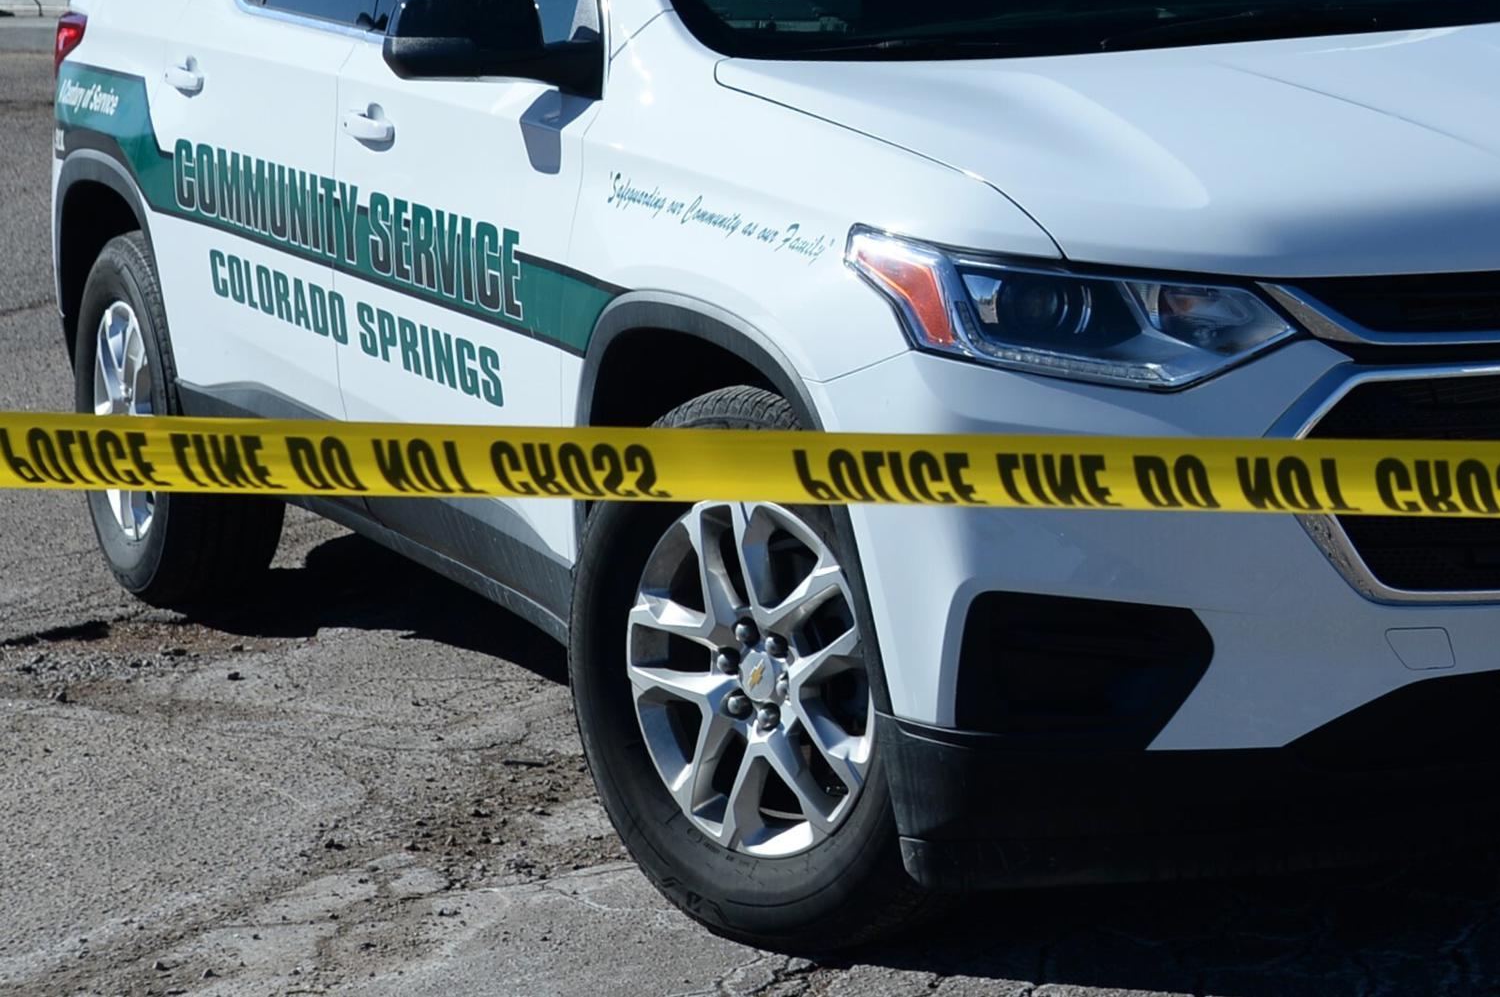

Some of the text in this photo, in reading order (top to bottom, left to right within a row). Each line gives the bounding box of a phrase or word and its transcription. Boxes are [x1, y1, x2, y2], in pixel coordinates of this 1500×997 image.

[174, 137, 524, 321] COMMUNITY SERVICE
[680, 194, 743, 239] Community
[209, 248, 504, 408] COLORADO SPRINGS
